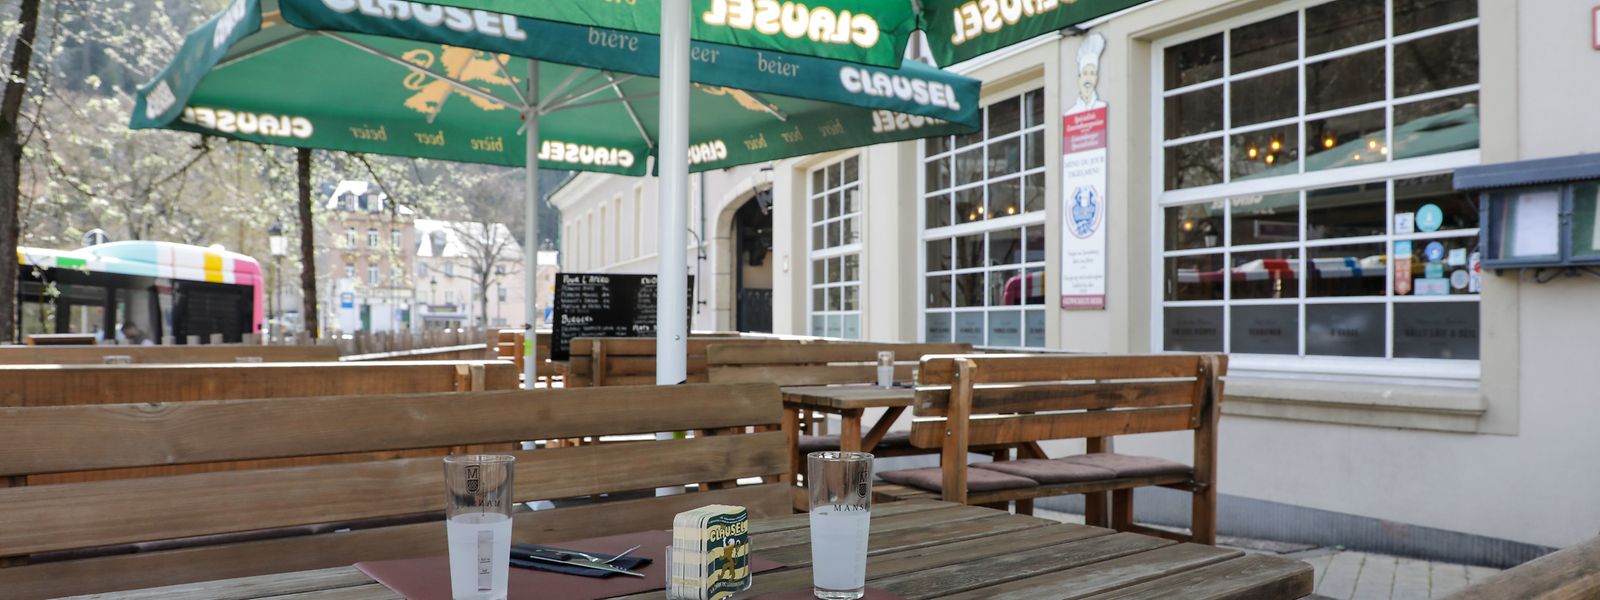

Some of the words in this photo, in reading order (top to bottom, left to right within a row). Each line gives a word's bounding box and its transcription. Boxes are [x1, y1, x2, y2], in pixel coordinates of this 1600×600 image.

[690, 44, 721, 64] eer
[757, 51, 801, 78] beier
[839, 66, 961, 111] CLAUSEL
[710, 521, 746, 543] CLAUSEL
